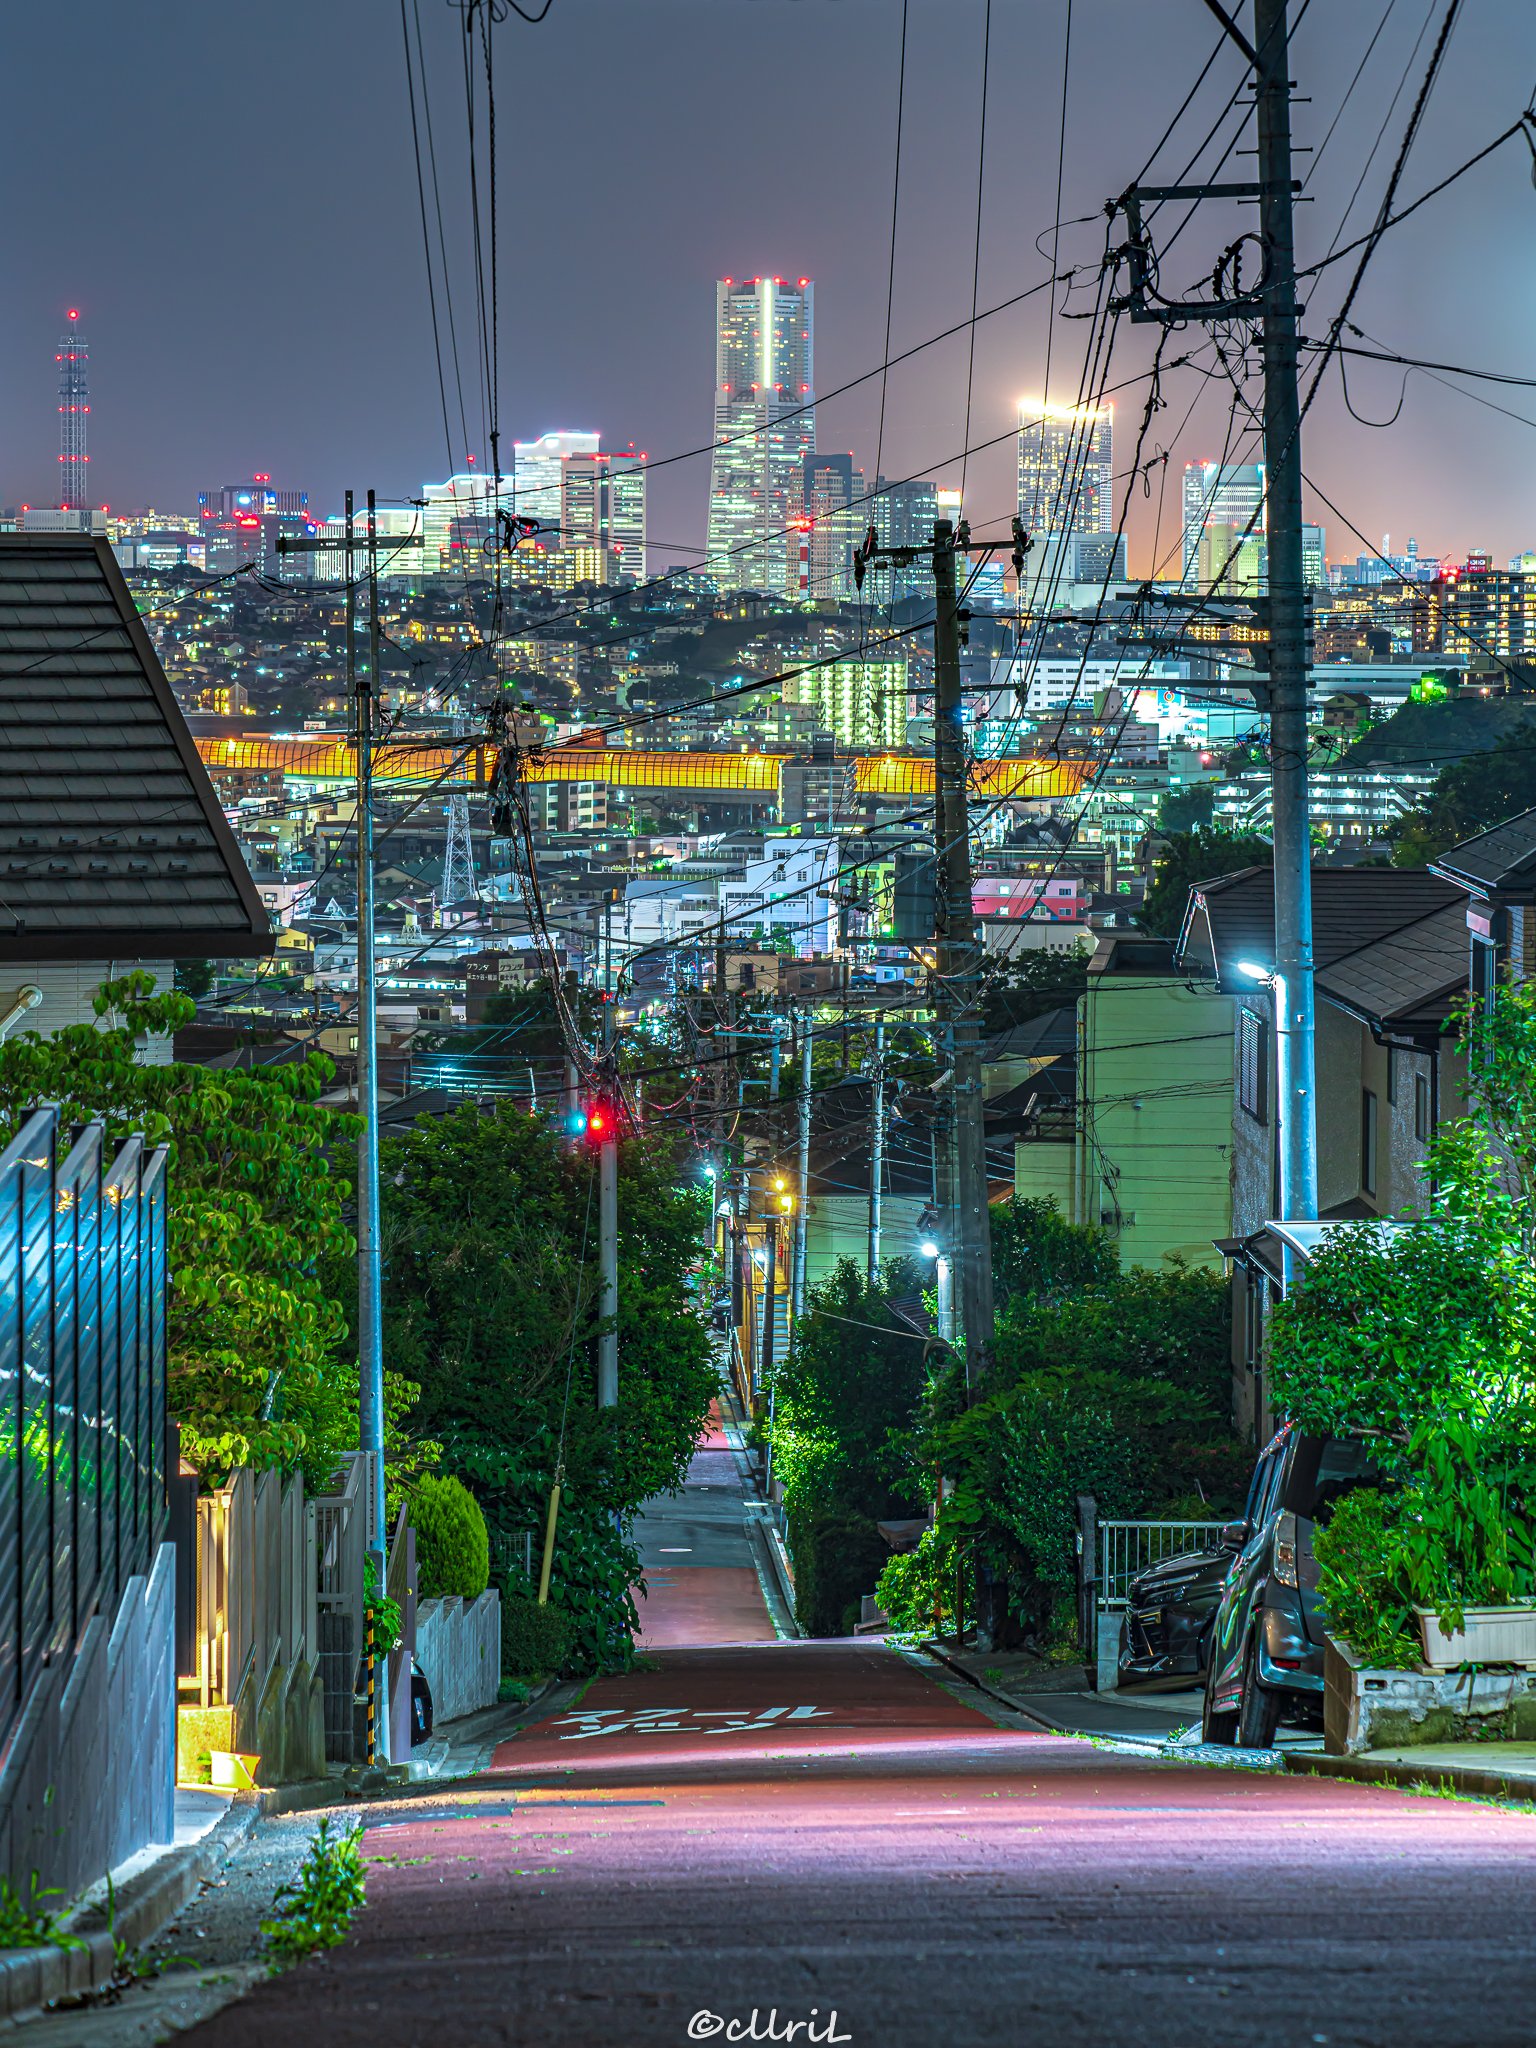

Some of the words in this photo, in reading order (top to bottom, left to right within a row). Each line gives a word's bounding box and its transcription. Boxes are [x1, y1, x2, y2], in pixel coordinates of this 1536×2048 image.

[551, 1706, 834, 1725] スクール
[559, 1721, 777, 1740] ゾーン
